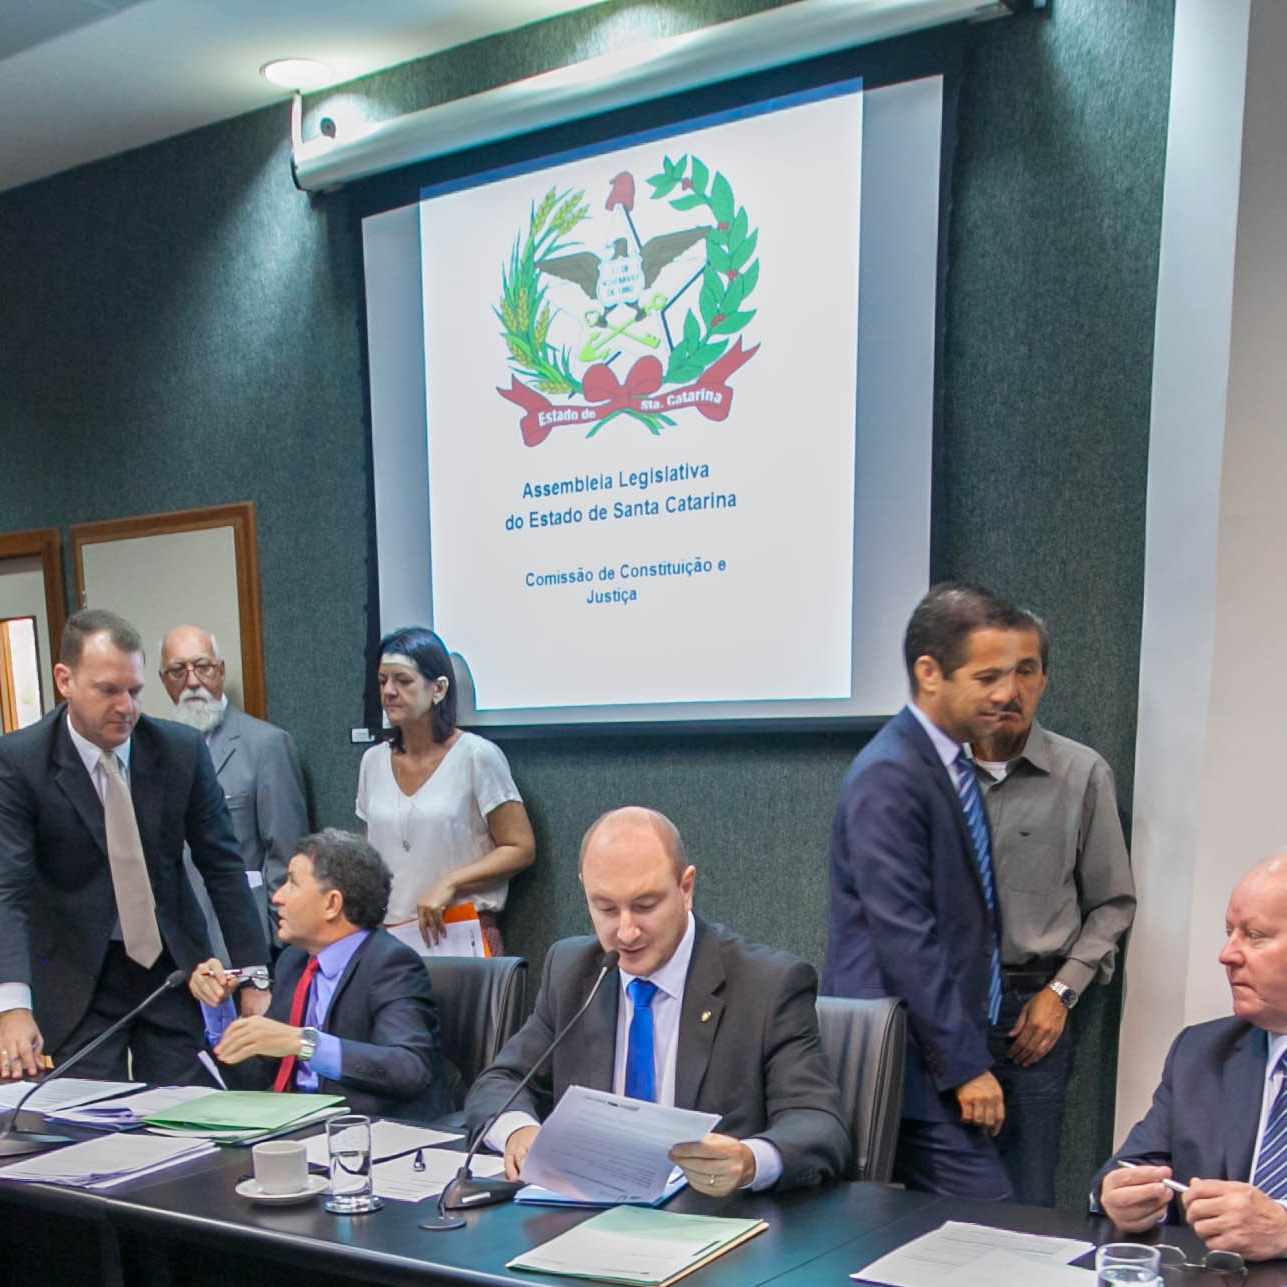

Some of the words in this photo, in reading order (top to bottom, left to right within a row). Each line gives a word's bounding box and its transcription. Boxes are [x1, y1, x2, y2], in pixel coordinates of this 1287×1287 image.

[538, 408, 578, 427] Estado
[581, 408, 596, 420] de
[640, 399, 664, 411] Sta.
[666, 387, 723, 406] Catarina
[522, 474, 613, 500] Assembleia
[619, 462, 710, 490] Legislativa
[505, 514, 524, 531] do
[529, 507, 583, 528] Estado
[588, 504, 608, 522] de
[613, 499, 660, 519] Santa
[665, 491, 737, 514] Catarina
[525, 567, 594, 587] Comissão
[598, 566, 615, 582] de
[620, 557, 713, 580] Constituição
[717, 559, 727, 573] e
[586, 588, 638, 606] Justiça
